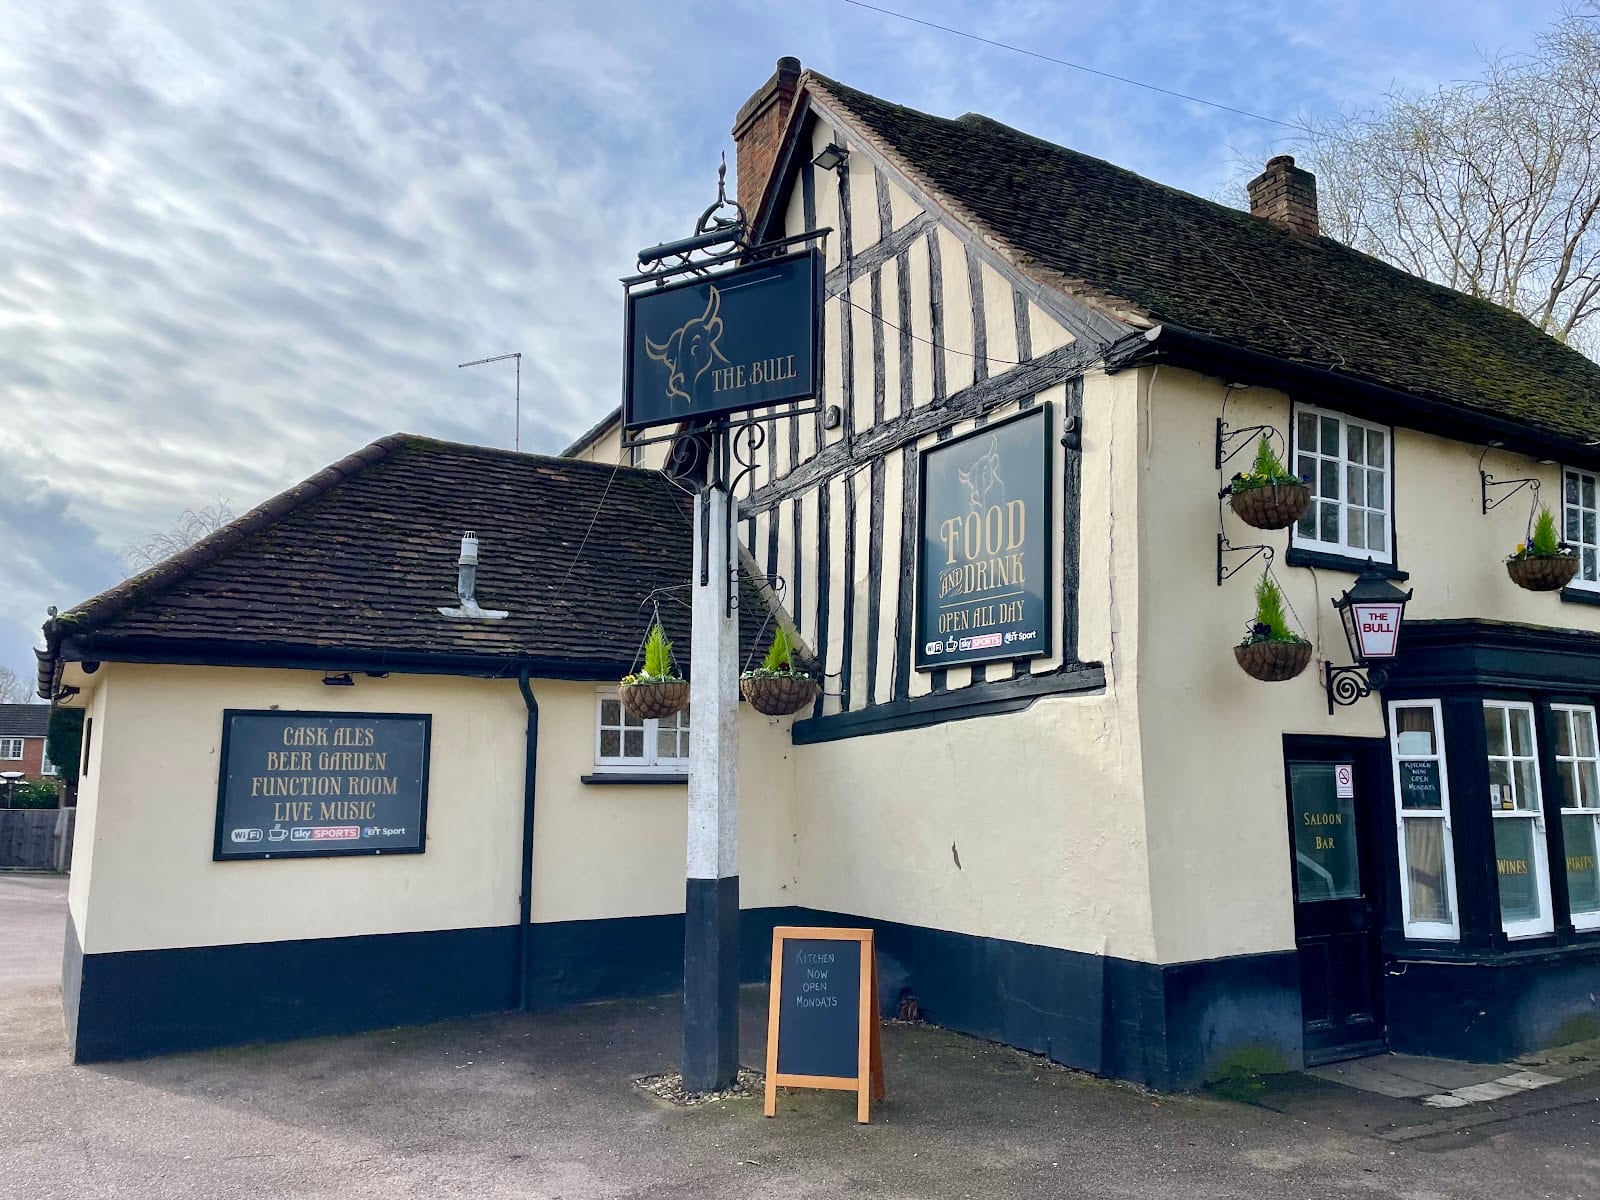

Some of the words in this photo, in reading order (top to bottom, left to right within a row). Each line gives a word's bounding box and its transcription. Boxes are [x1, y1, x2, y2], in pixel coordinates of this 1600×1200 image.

[712, 365, 745, 392] THE
[750, 355, 797, 385] BULL
[940, 499, 1026, 565] FOOD
[939, 567, 963, 599] AND
[963, 552, 1026, 594] DRINK
[938, 609, 970, 634] OPEN
[972, 605, 996, 628] ALL
[999, 600, 1025, 624] DAY
[1368, 612, 1389, 621] THE
[1363, 623, 1394, 633] BULL
[972, 636, 1000, 647] SPORTS
[1018, 630, 1037, 641] Sport
[283, 726, 329, 746] CASK
[332, 728, 375, 746] ALES
[267, 751, 312, 771] BEER
[318, 752, 387, 771] GARDEN
[251, 777, 341, 797] FUNCTION
[348, 776, 398, 795] ROOM
[273, 802, 313, 822] LIVE
[319, 801, 376, 820] MUSIC
[1303, 812, 1342, 826] SALOON
[232, 830, 262, 841] WiFi
[294, 829, 311, 840] sky
[312, 827, 357, 839] SPORTS
[367, 826, 381, 836] BT
[382, 826, 406, 836] Sport
[1315, 836, 1335, 850] BAR
[1496, 859, 1528, 875] WINES
[1566, 855, 1594, 872] PIRITS
[795, 949, 835, 965] KITCHEN
[807, 968, 828, 980] NOW
[802, 982, 827, 993] OPEN
[796, 995, 838, 1009] MONDAYS
